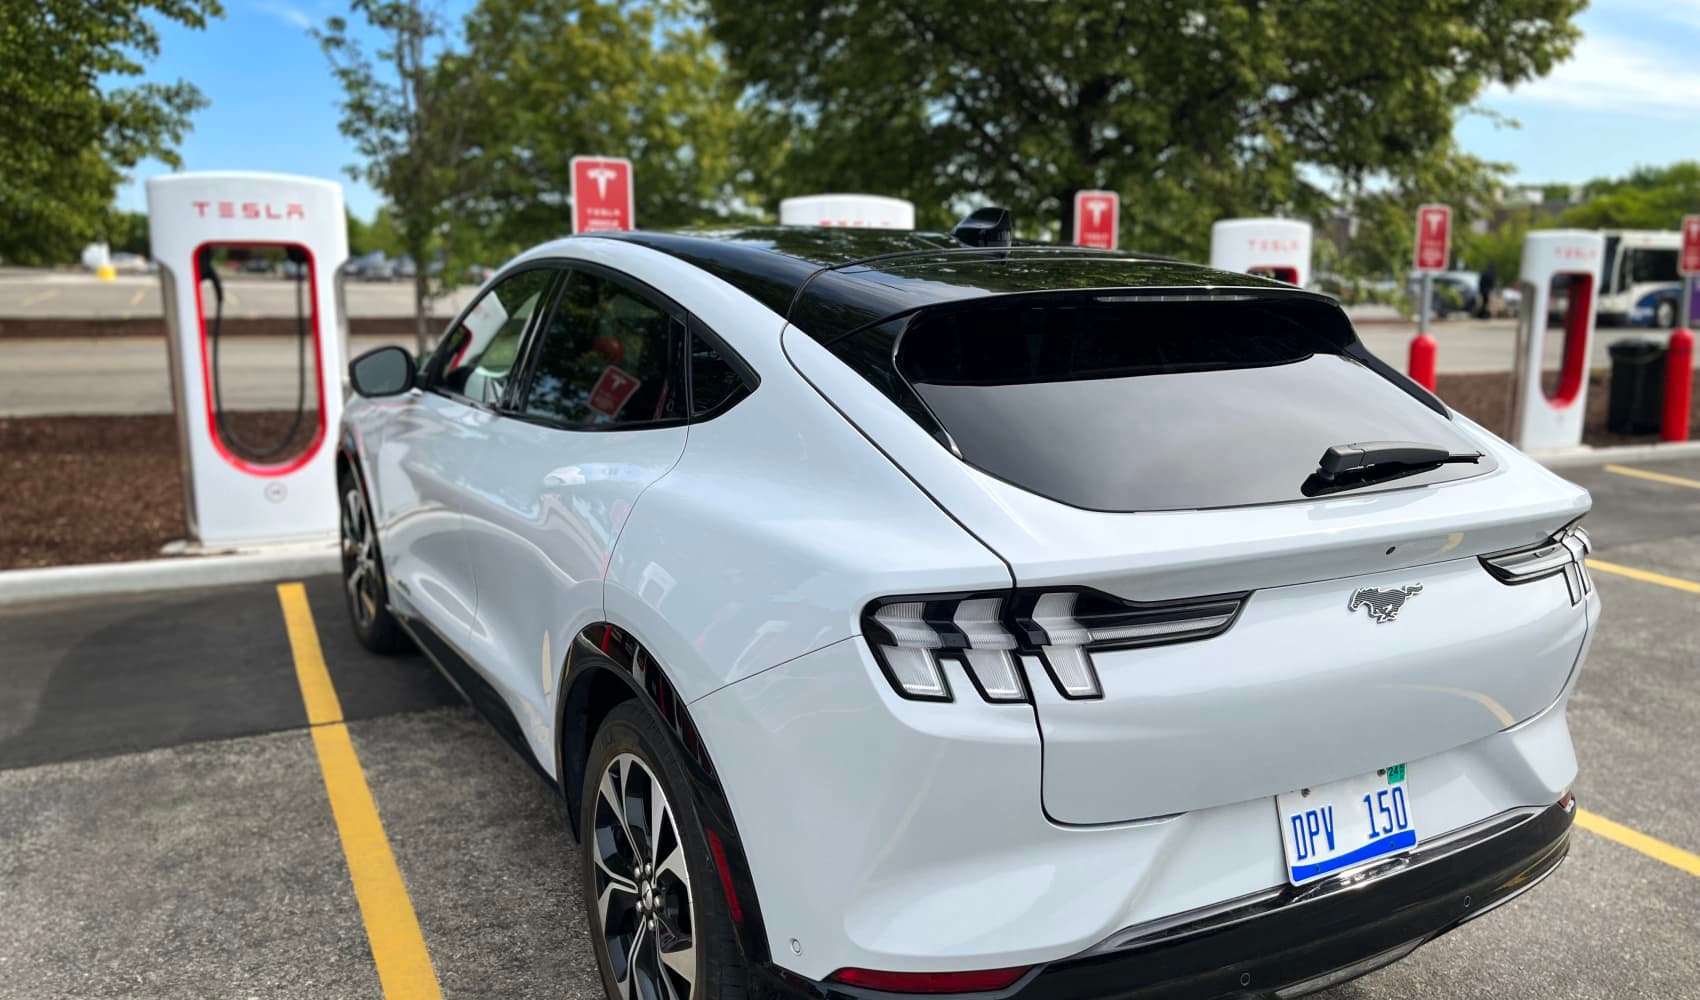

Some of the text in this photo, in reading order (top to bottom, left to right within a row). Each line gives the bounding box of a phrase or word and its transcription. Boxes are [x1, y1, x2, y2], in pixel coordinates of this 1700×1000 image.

[193, 201, 304, 219] TESLA
[1291, 786, 1408, 861] DPV 150
